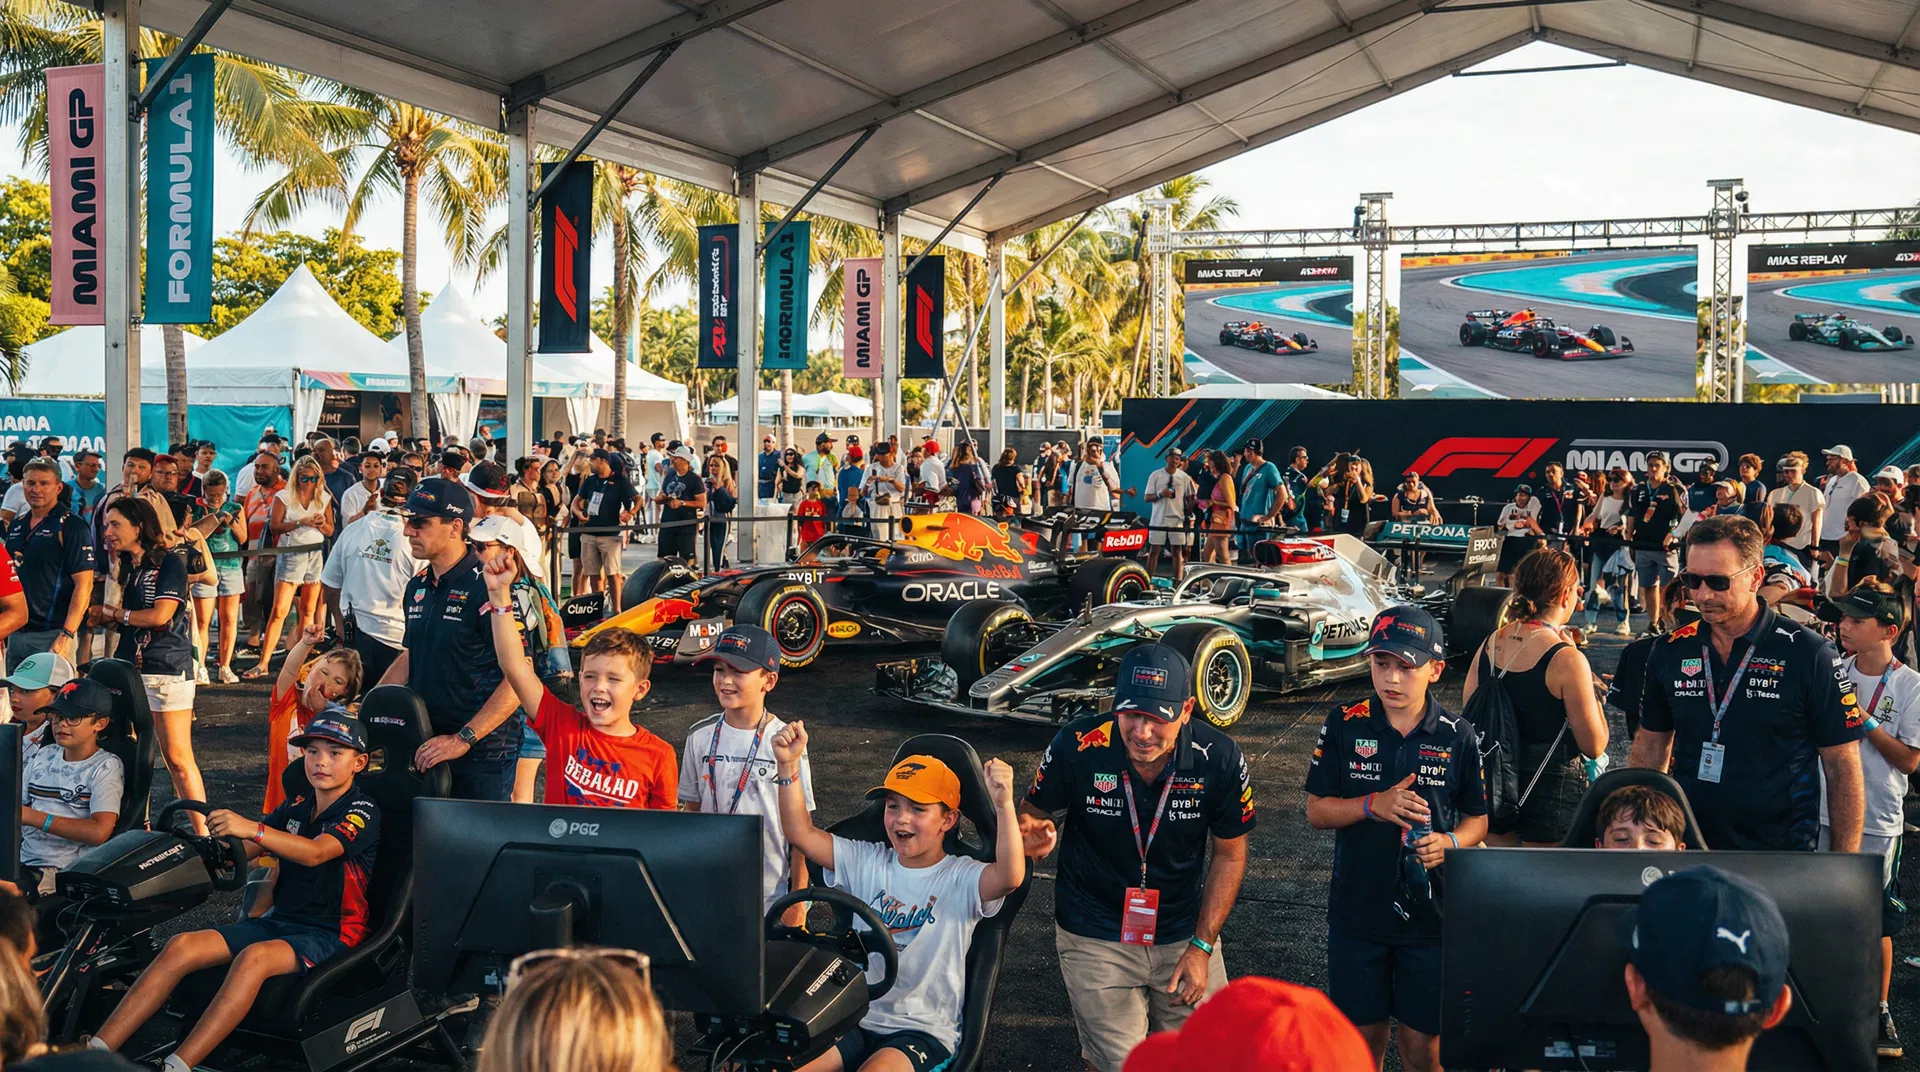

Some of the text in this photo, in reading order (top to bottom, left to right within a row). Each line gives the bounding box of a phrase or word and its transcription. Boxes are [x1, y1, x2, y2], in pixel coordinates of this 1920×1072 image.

[69, 88, 97, 305] MIAMI GP
[168, 73, 193, 303] FORMULA 1
[1800, 254, 1848, 265] REPLAY
[856, 268, 871, 368] MIAMI GP
[902, 581, 1000, 602] ORACLE
[1749, 678, 1779, 688] BYBIT
[1172, 797, 1200, 808] BYBIT
